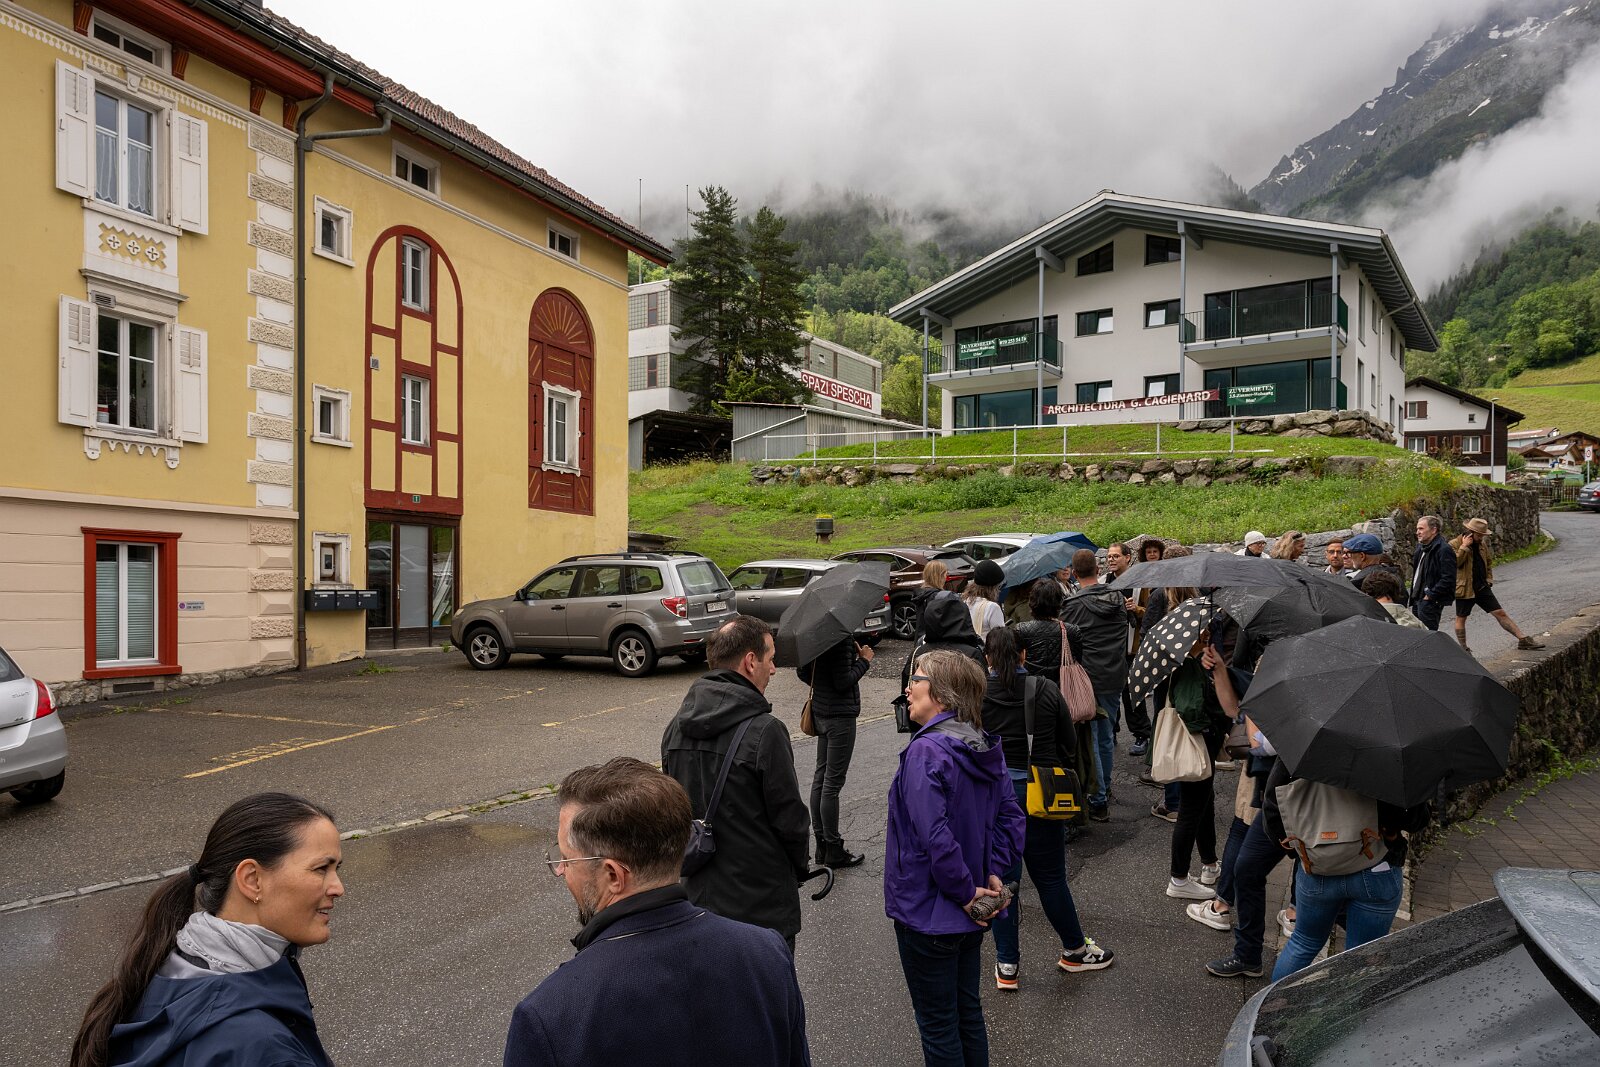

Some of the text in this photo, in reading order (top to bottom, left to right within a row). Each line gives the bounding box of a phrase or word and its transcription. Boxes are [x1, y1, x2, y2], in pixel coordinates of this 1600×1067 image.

[802, 374, 872, 408] SPAZI SPESCHA
[1048, 391, 1211, 414] ARCHITECTURA G. CAGIENARD
